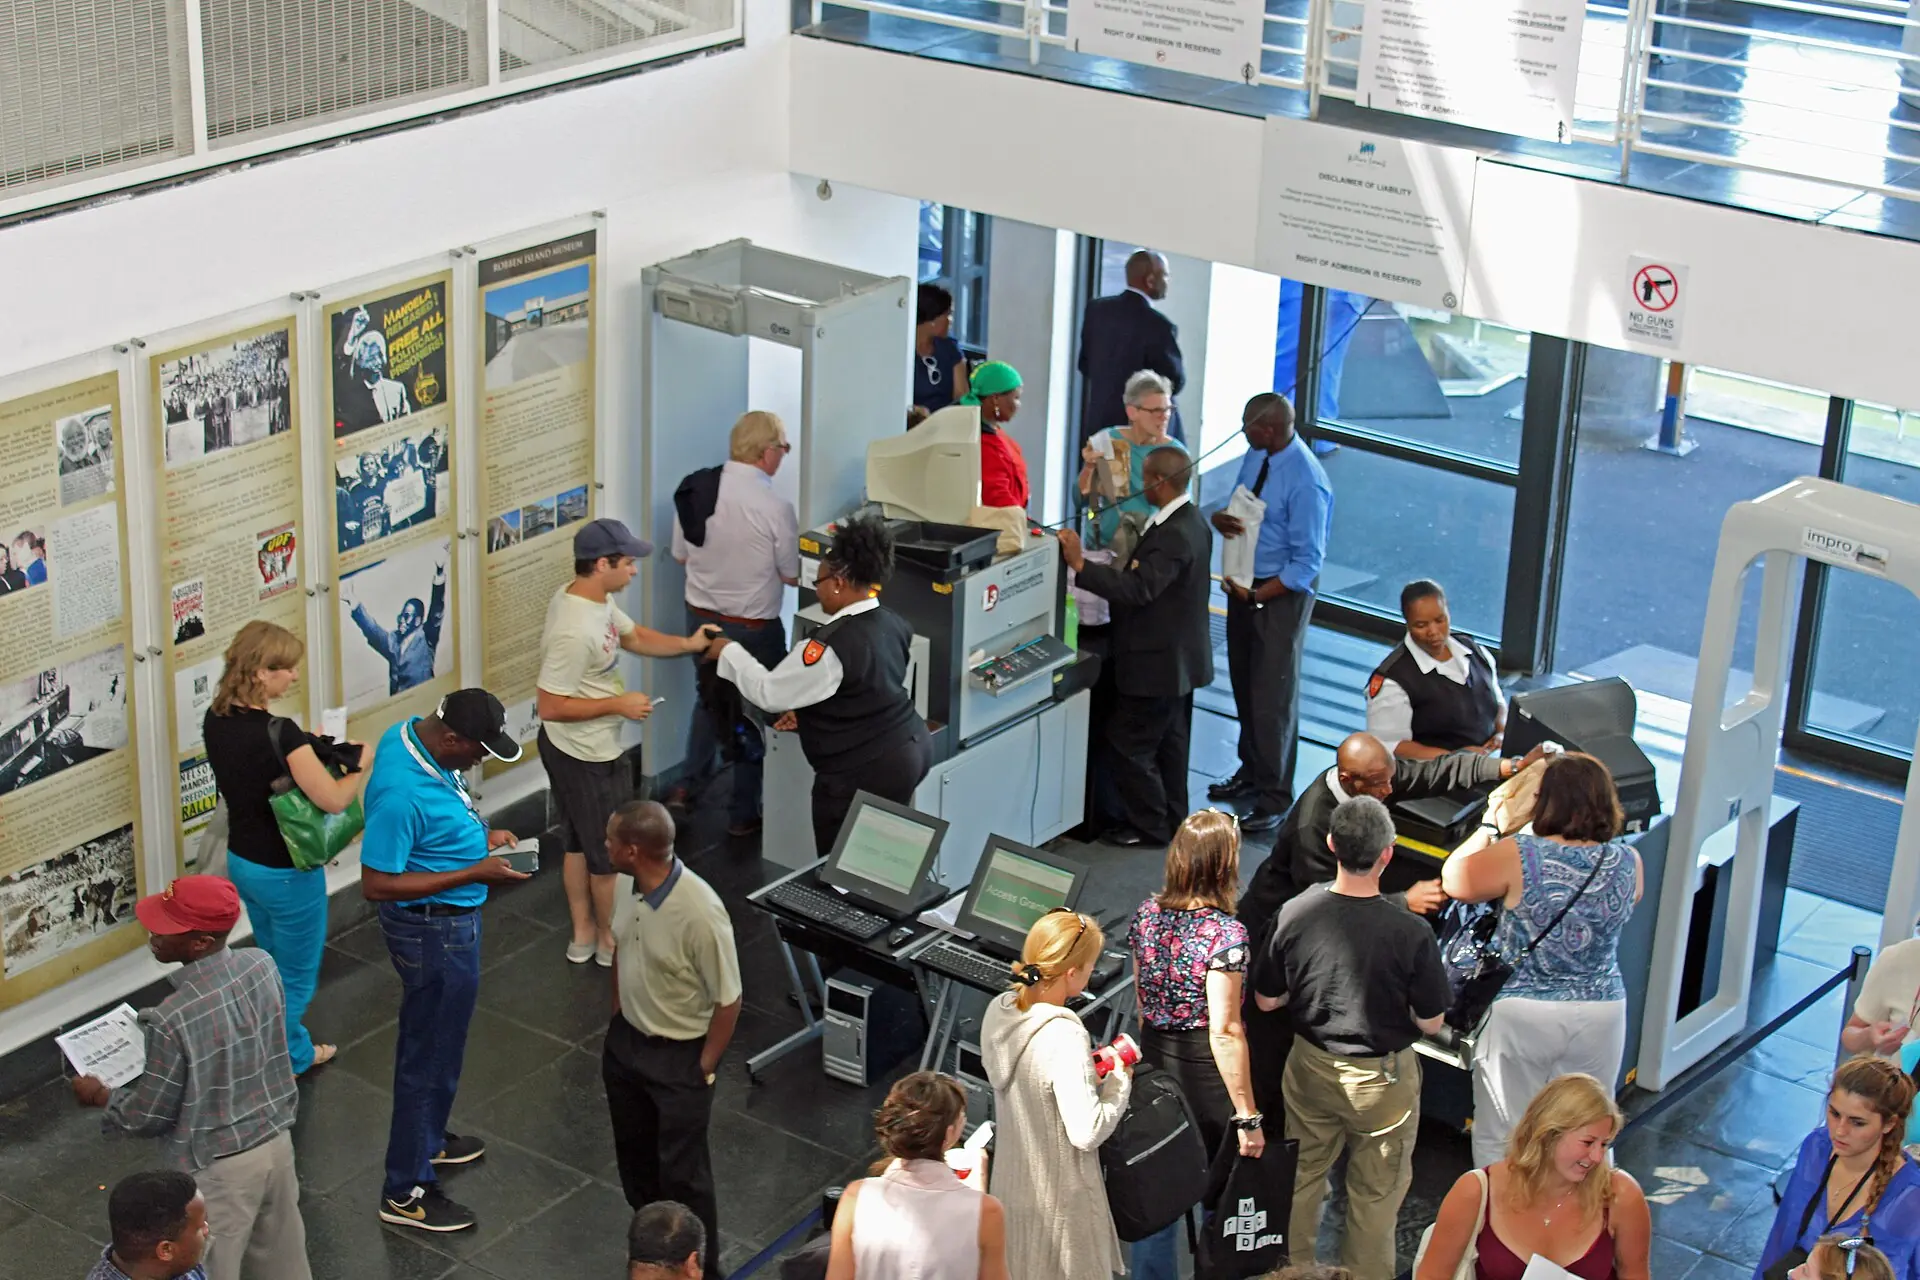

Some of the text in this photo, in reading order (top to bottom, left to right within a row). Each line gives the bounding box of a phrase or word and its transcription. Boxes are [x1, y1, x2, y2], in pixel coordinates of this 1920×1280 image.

[1125, 31, 1134, 39] OF
[1137, 35, 1174, 46] ADMISSION
[1184, 42, 1222, 56] RESERVED
[1318, 172, 1412, 197] DISCLAIMER OF LIABILITY
[493, 240, 583, 272] ROBBEN ISLAND MUSEUM
[1296, 253, 1318, 265] RIGHT
[1320, 259, 1329, 267] OF
[1331, 261, 1371, 276] ADMISSION
[1382, 272, 1422, 287] RESERVED
[383, 288, 432, 329] MANDELA
[1629, 311, 1674, 329] NO GUNS
[388, 311, 444, 358] FREE ALL
[267, 531, 292, 552] UDF
[1807, 529, 1852, 552] impro
[182, 793, 215, 820] RALLY
[985, 885, 1018, 903] Access
